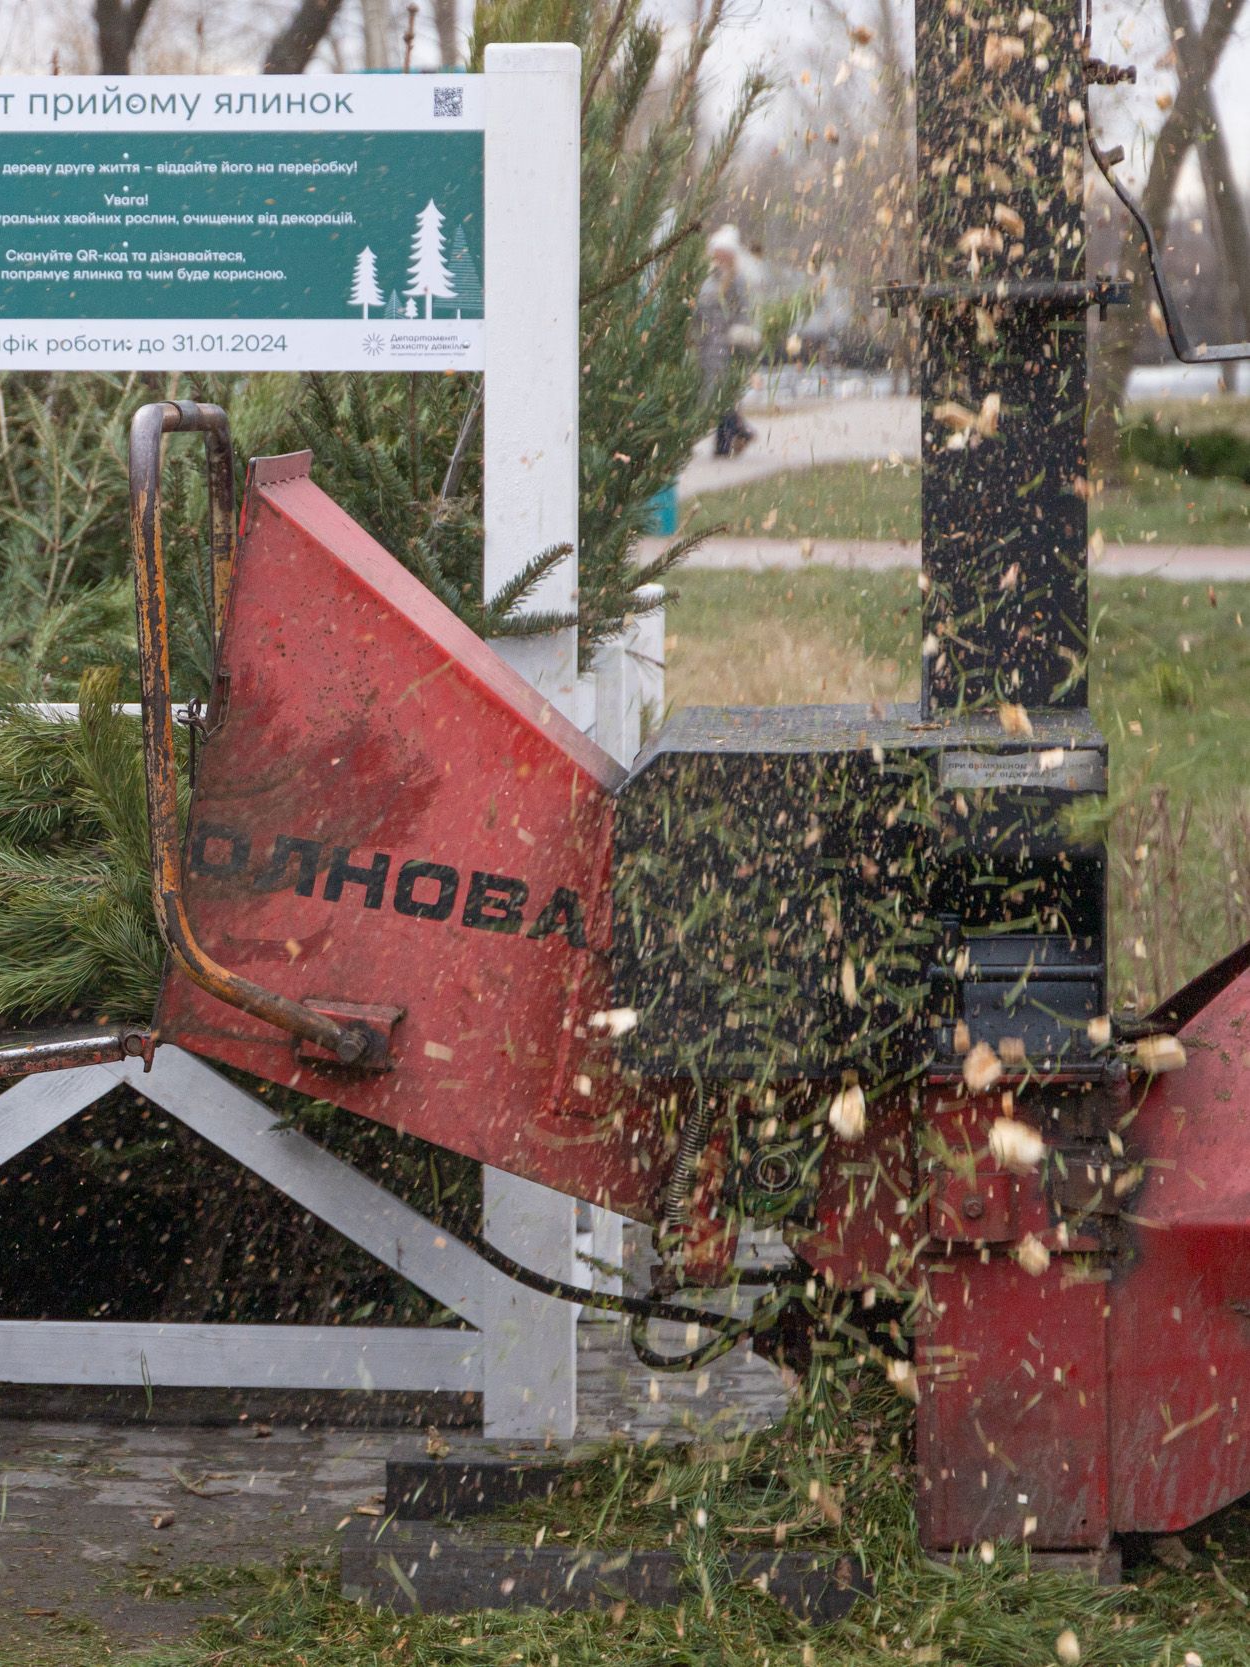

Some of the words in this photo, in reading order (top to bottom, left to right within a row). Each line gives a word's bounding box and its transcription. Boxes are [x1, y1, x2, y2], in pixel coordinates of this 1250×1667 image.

[28, 86, 202, 122] прийому
[213, 92, 355, 115] ялинок
[1, 163, 52, 176] дереву
[54, 163, 96, 176] друге
[98, 163, 141, 174] життя
[156, 160, 218, 175] віддайте
[221, 160, 254, 174] його
[256, 163, 275, 174] на
[278, 161, 358, 176] переробку!
[103, 193, 149, 207] Увага!
[63, 211, 122, 225] хвойних
[124, 214, 180, 227] рослин,
[182, 214, 254, 226] очищених
[257, 211, 278, 226] від
[280, 211, 357, 227] декорацій.
[5, 248, 74, 264] Скануйте
[76, 249, 129, 263] QR-код
[131, 251, 147, 262] та
[149, 249, 246, 264] дізнавайтеся,
[0, 270, 70, 282] попрямує
[72, 270, 124, 281] ялинка
[126, 270, 143, 281] та
[145, 270, 174, 281] чим
[176, 267, 211, 282] буде
[213, 270, 287, 282] корисною.
[138, 339, 165, 354] до
[172, 334, 288, 352] 31.01.2024
[431, 342, 470, 351] довкілл
[190, 821, 588, 949] ОЛНОВА
